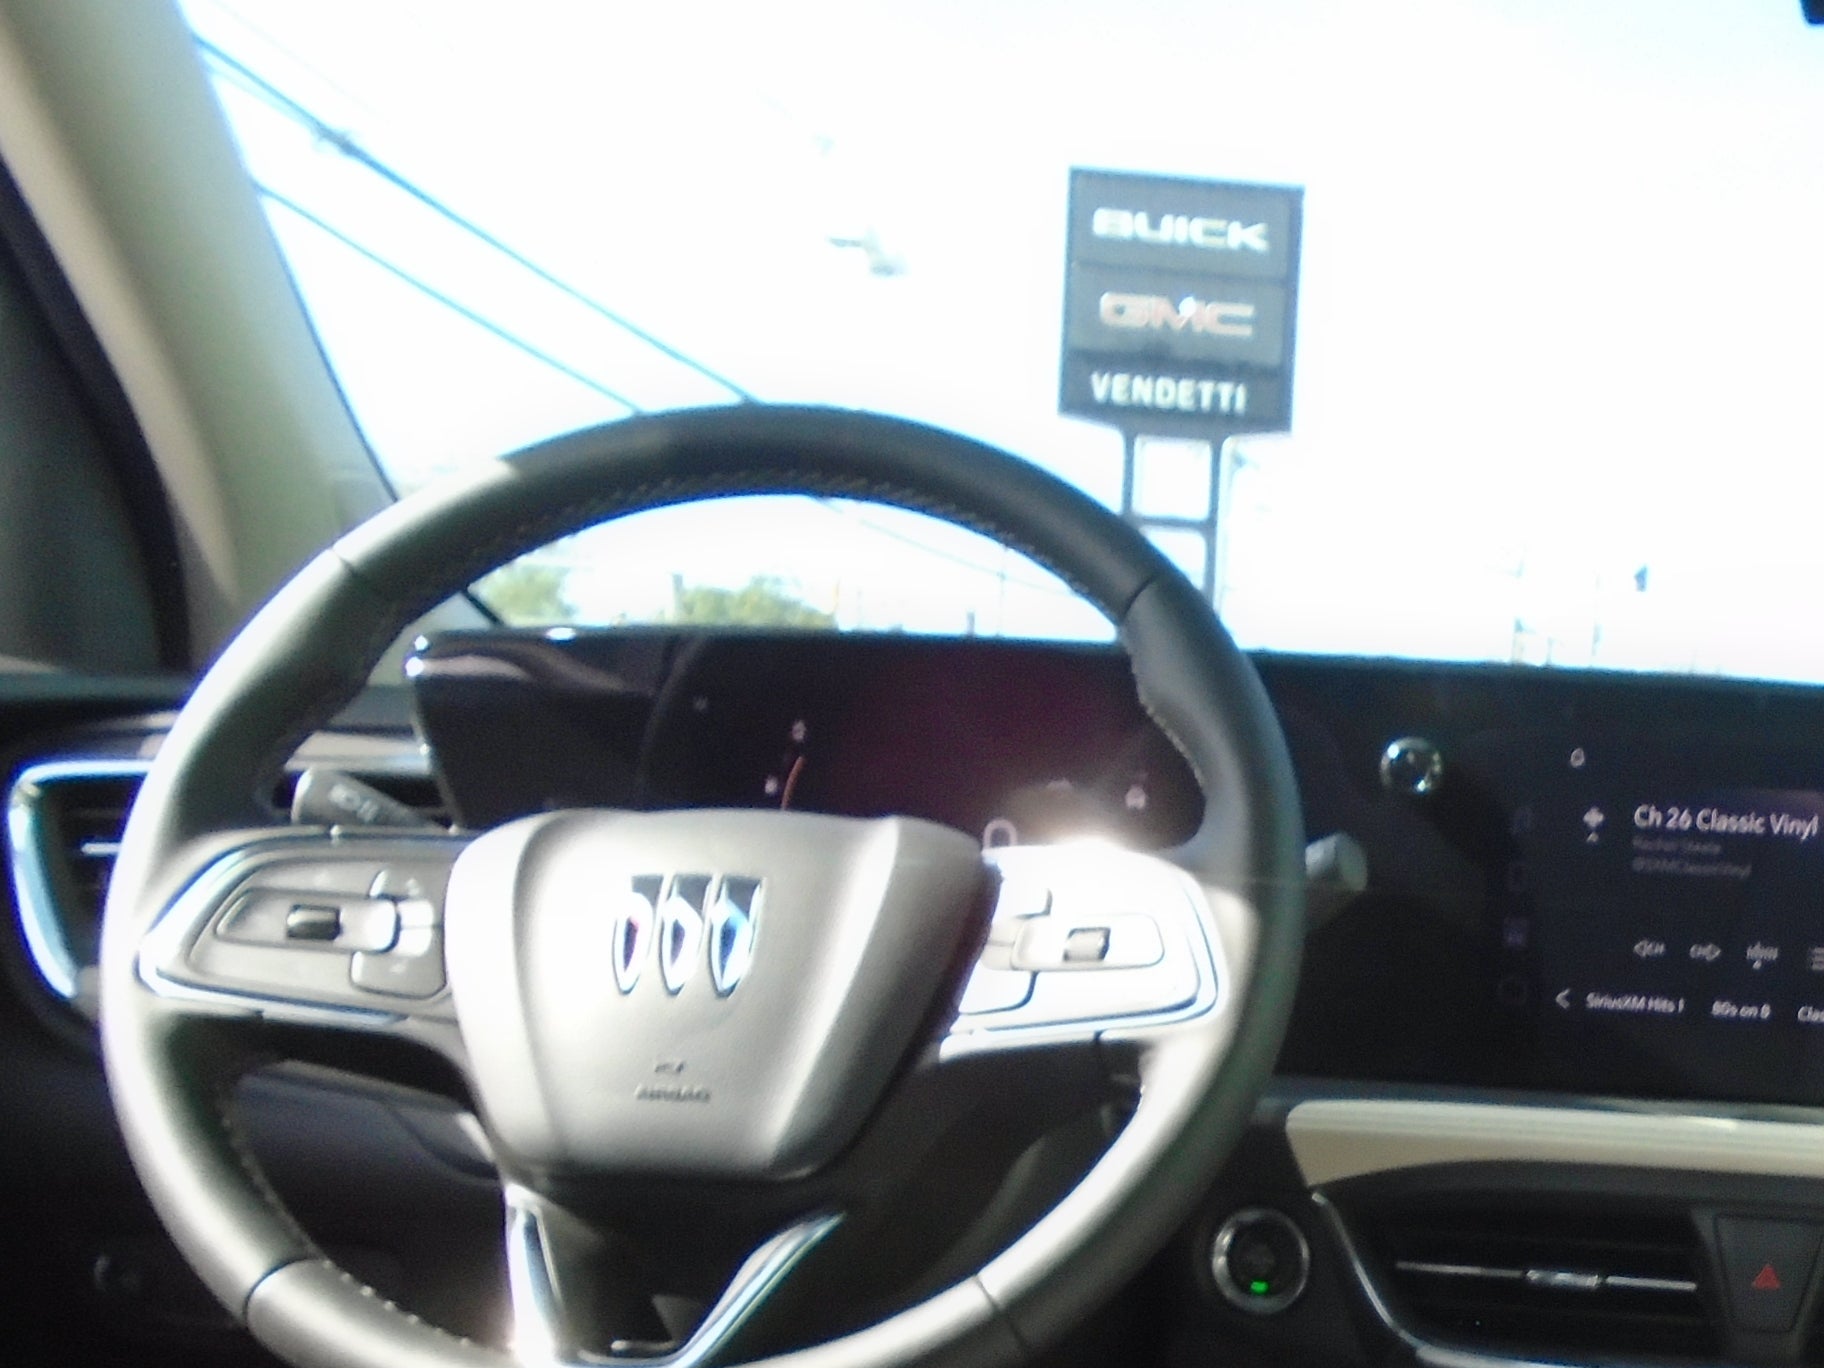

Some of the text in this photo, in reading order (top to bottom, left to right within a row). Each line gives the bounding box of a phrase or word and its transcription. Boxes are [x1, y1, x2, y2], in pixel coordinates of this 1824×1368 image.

[1093, 207, 1270, 251] BUICK
[1100, 291, 1255, 336] GMC
[1090, 371, 1248, 415] VENDETTI
[1634, 804, 1819, 841] Ch 26 Classic Vinyl
